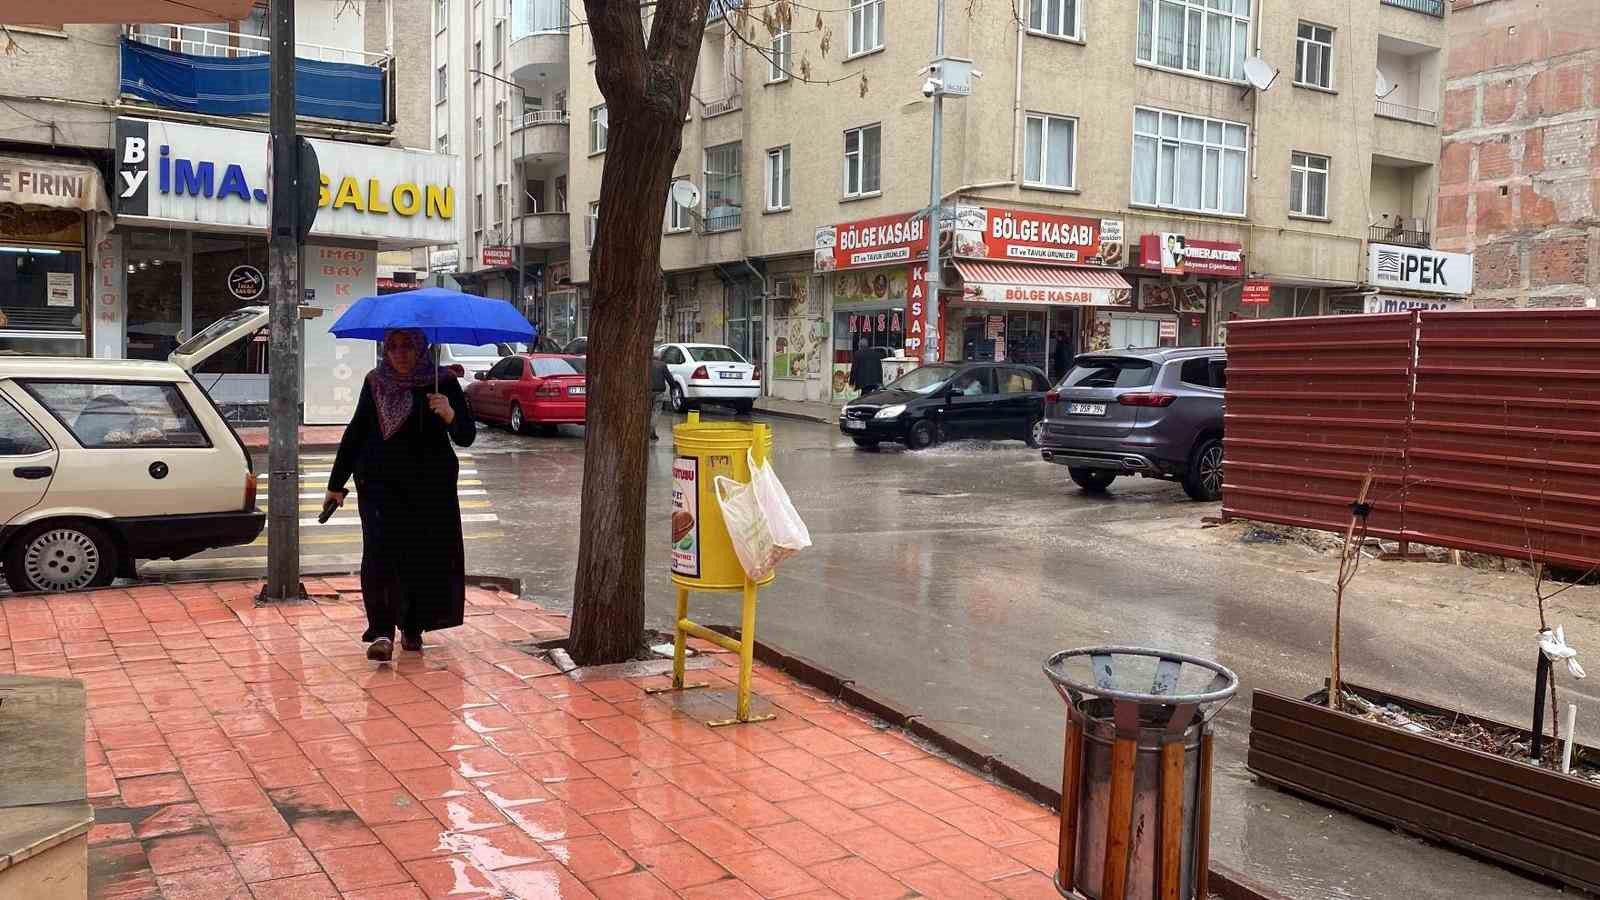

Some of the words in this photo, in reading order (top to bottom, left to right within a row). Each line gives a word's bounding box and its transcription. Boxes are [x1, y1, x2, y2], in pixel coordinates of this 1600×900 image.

[18, 171, 83, 199] FIRINI
[159, 144, 267, 202] İMA
[840, 225, 877, 251] BÖLGE
[879, 219, 924, 246] KASABI
[992, 212, 1039, 242] BÖLGE
[1042, 221, 1093, 246] KASABI
[1027, 249, 1047, 258] TAVUK
[320, 265, 364, 278] BAY
[911, 266, 923, 351] KASAP
[1006, 288, 1045, 301] BÖLGE
[1047, 291, 1092, 304] KASABI
